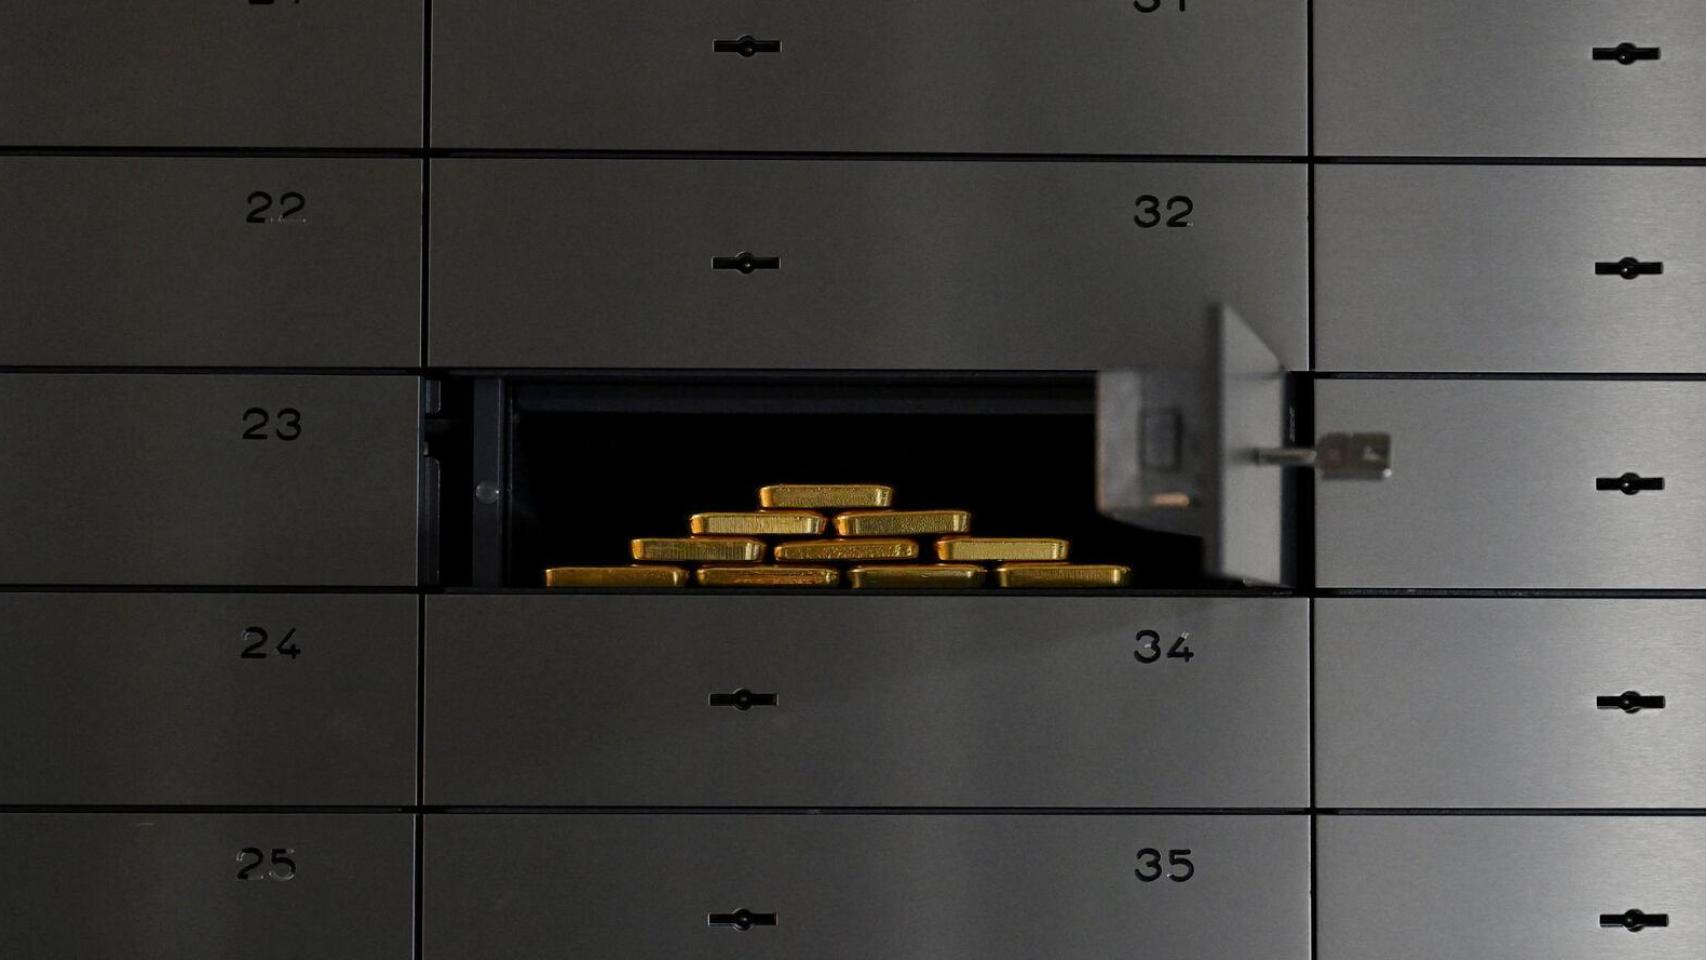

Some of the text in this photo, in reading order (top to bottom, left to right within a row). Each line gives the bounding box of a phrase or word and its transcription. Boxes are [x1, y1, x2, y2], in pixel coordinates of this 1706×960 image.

[246, 191, 306, 223] 22
[1134, 195, 1194, 227] 32
[242, 407, 301, 441] 23
[241, 627, 301, 659] 24
[1134, 630, 1194, 663] 34
[237, 847, 297, 881] 25
[1135, 848, 1194, 882] 35
